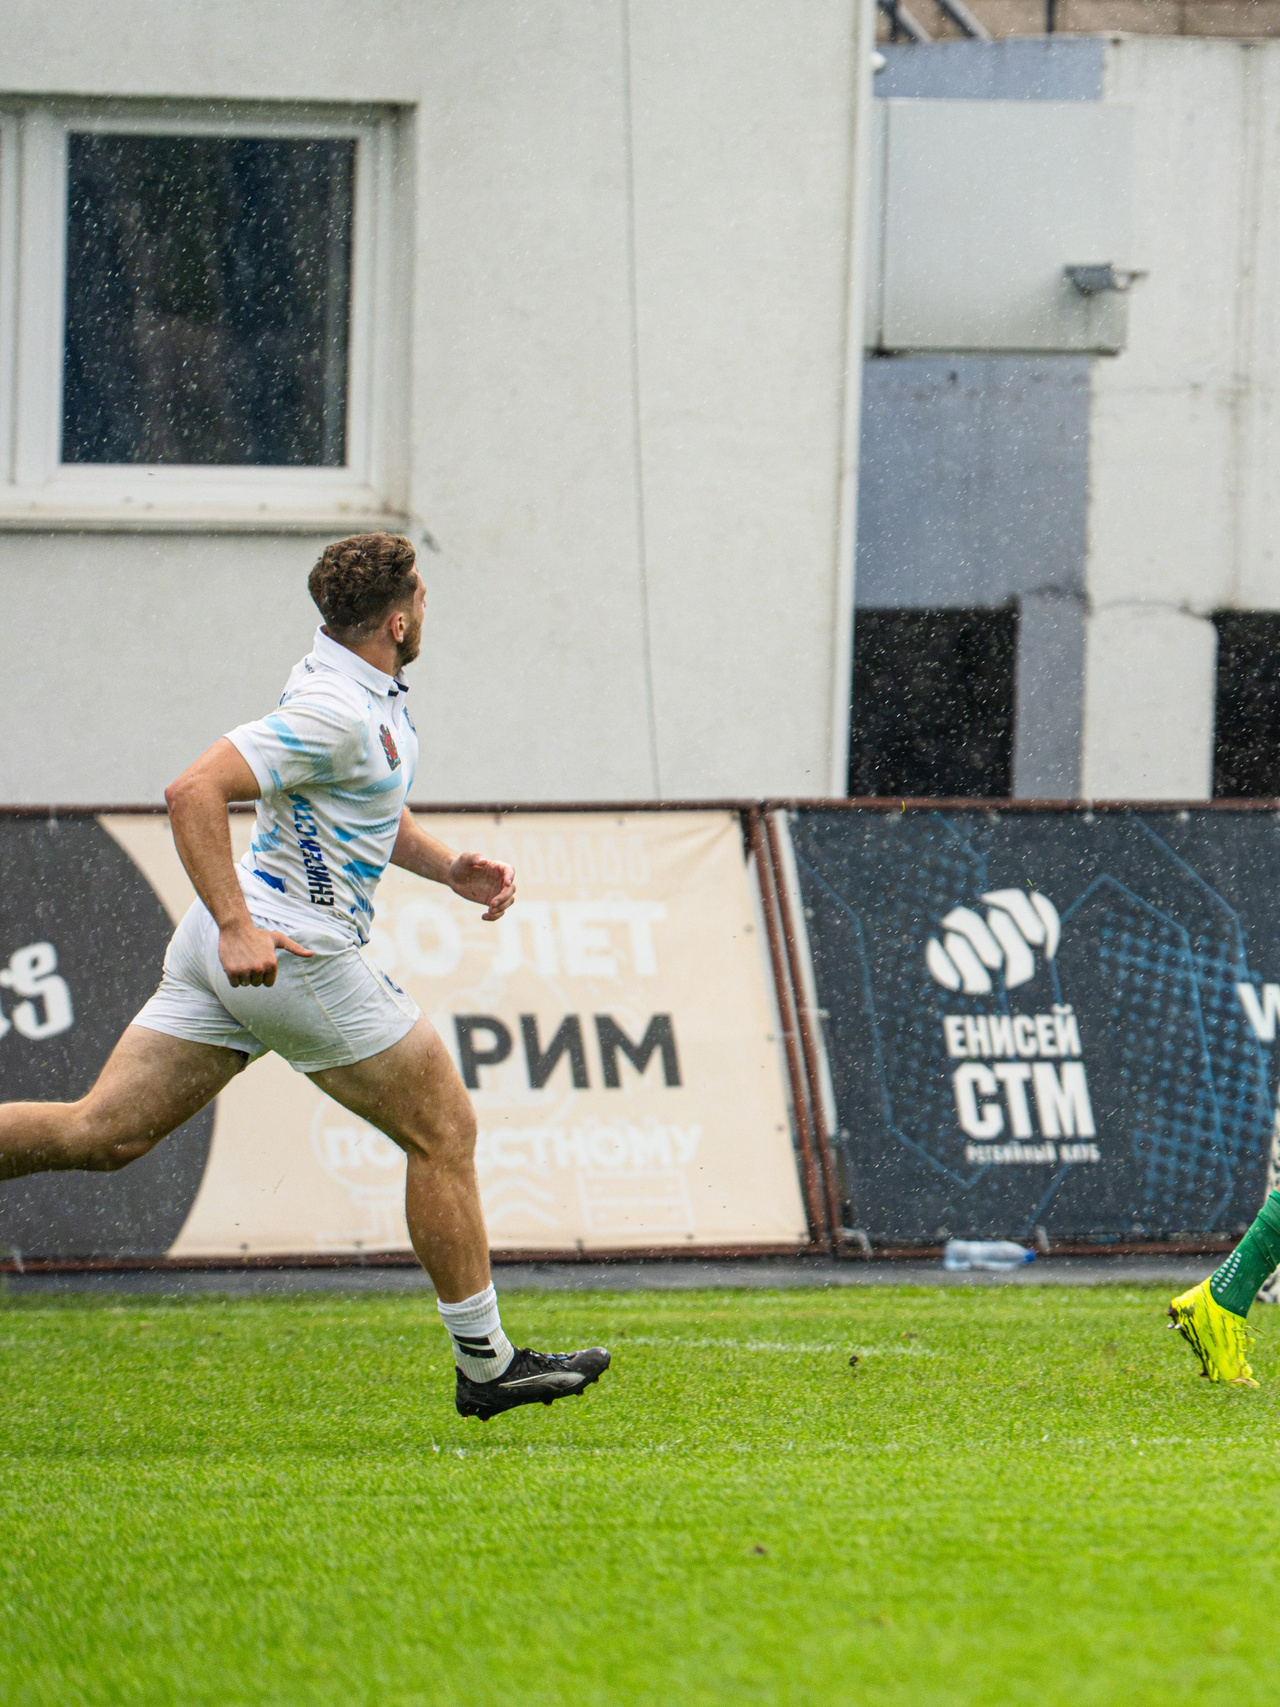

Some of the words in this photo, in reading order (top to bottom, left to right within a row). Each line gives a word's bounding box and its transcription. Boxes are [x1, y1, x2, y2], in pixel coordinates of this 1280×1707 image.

[491, 900, 669, 977] ЛЕТ
[453, 1012, 684, 1090] РИМ
[943, 1003, 1083, 1059] ЕНИСЕЙ
[953, 1060, 1097, 1141] СТМ
